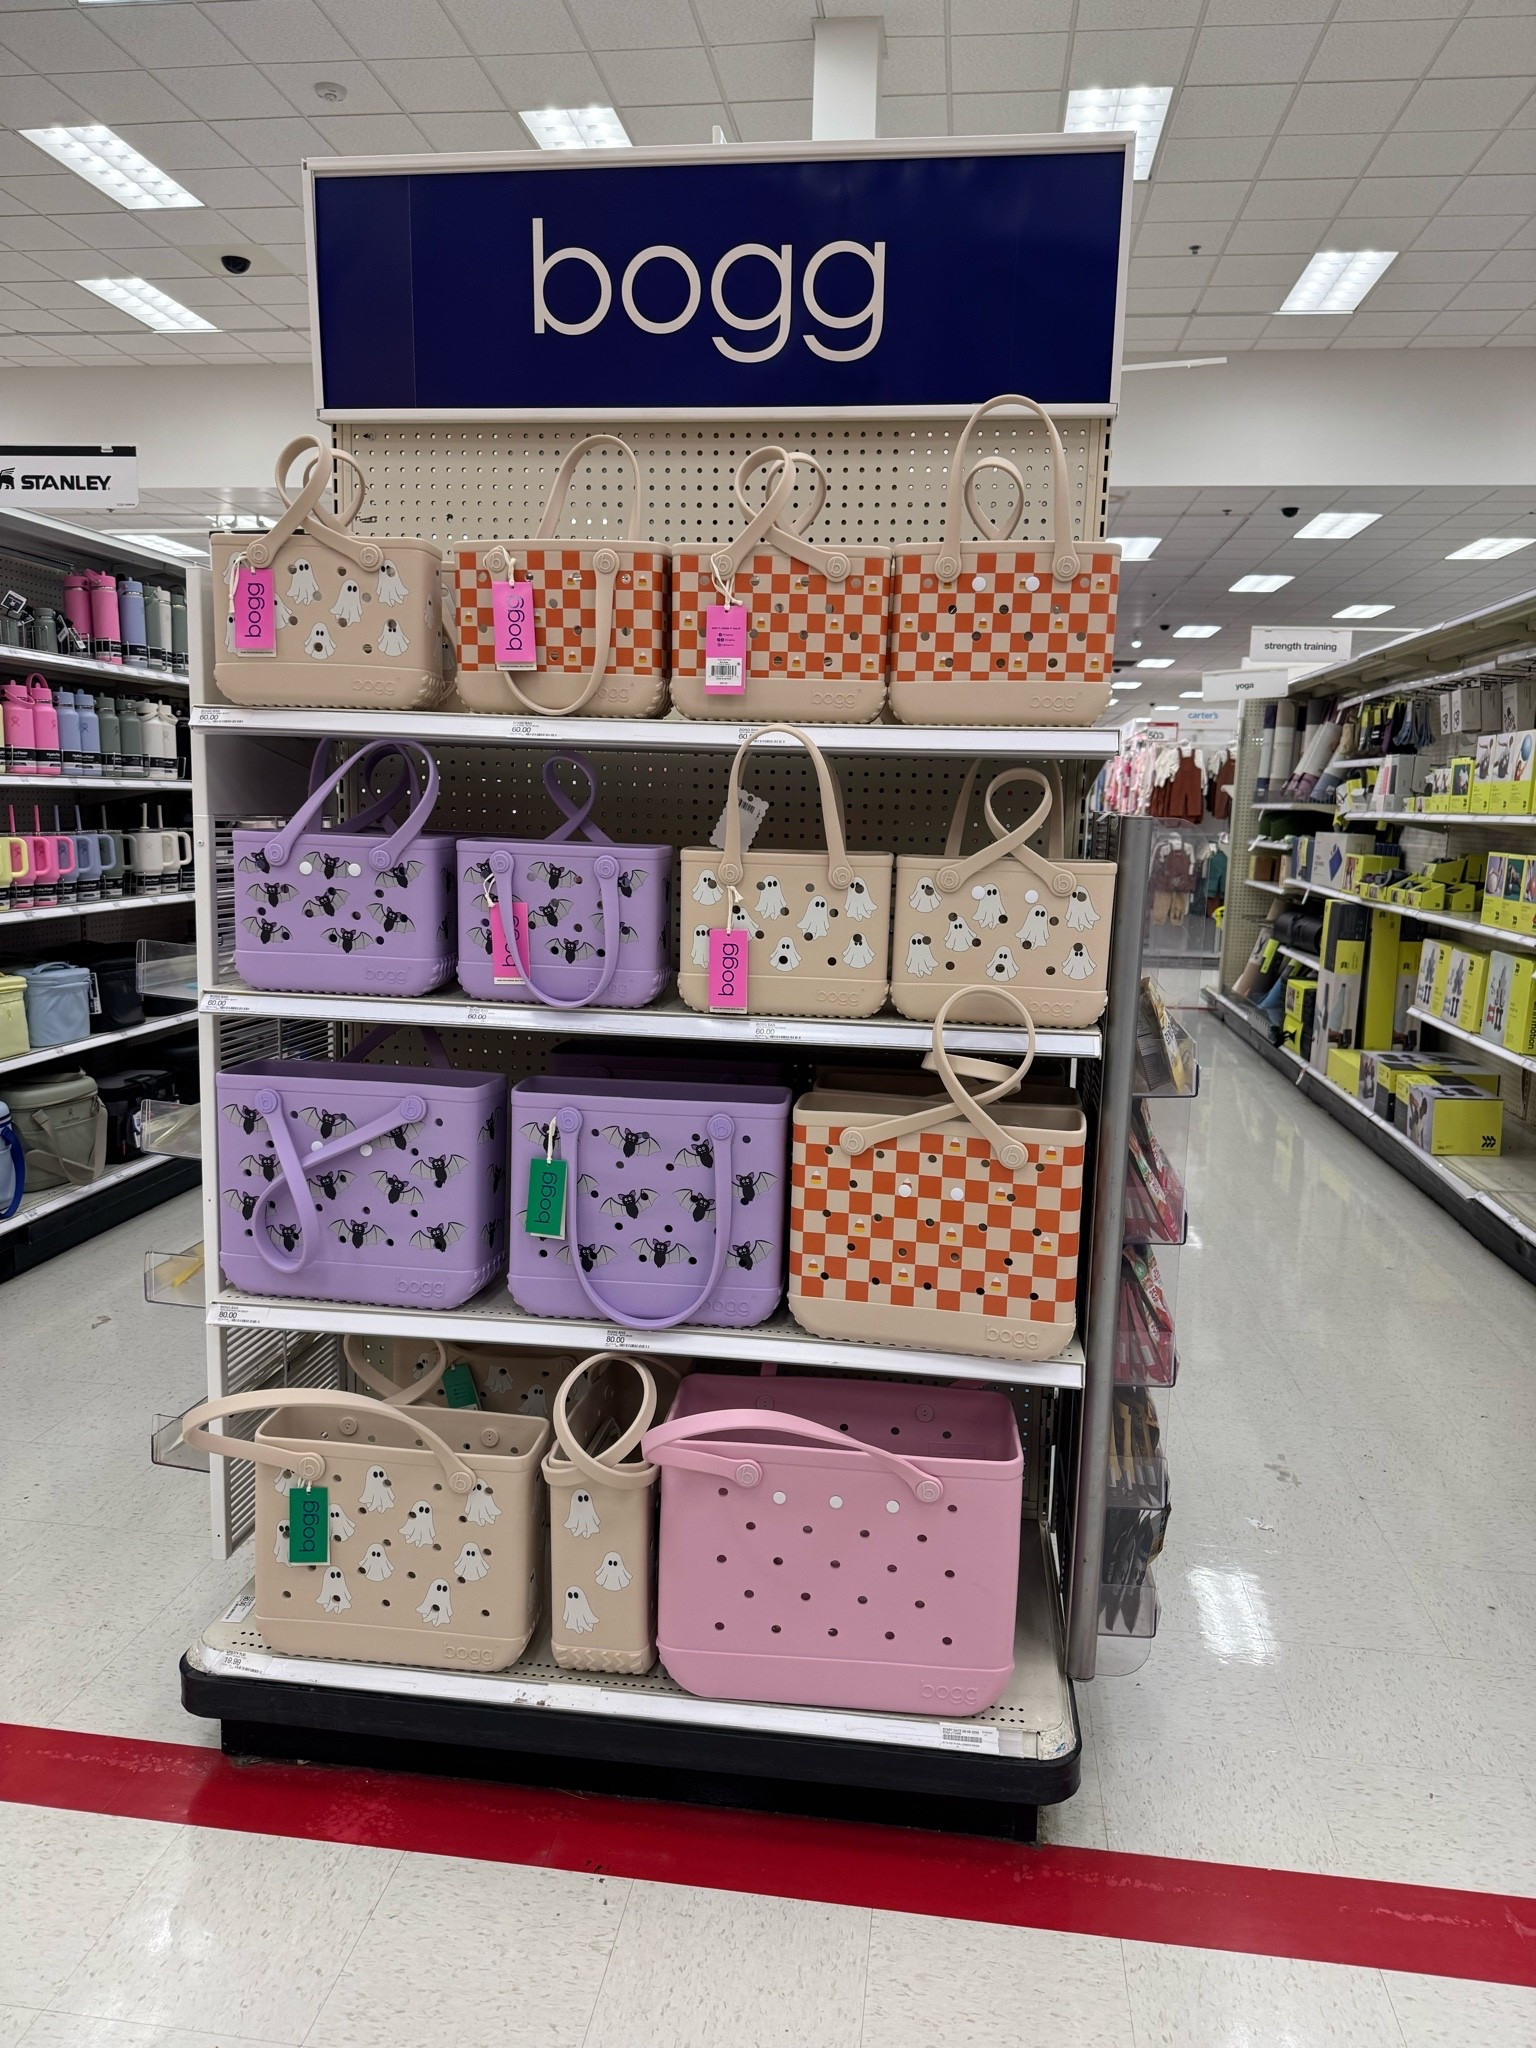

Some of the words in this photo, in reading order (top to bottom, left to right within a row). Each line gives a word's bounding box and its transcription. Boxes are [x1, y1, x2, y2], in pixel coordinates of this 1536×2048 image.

[532, 217, 886, 363] bogg
[21, 475, 111, 490] STANLEY
[245, 583, 265, 637] bogg
[505, 595, 525, 650] bogg
[1264, 642, 1301, 651] strength
[1304, 643, 1337, 652] training
[1235, 682, 1254, 691] yoga
[718, 943, 739, 996] bogg
[535, 1172, 557, 1224] bogg
[985, 1324, 1040, 1350] bogg
[298, 1501, 320, 1552] bogg
[224, 1656, 241, 1666] 19.99
[443, 1641, 494, 1664] bogg
[921, 1680, 979, 1704] bogg
